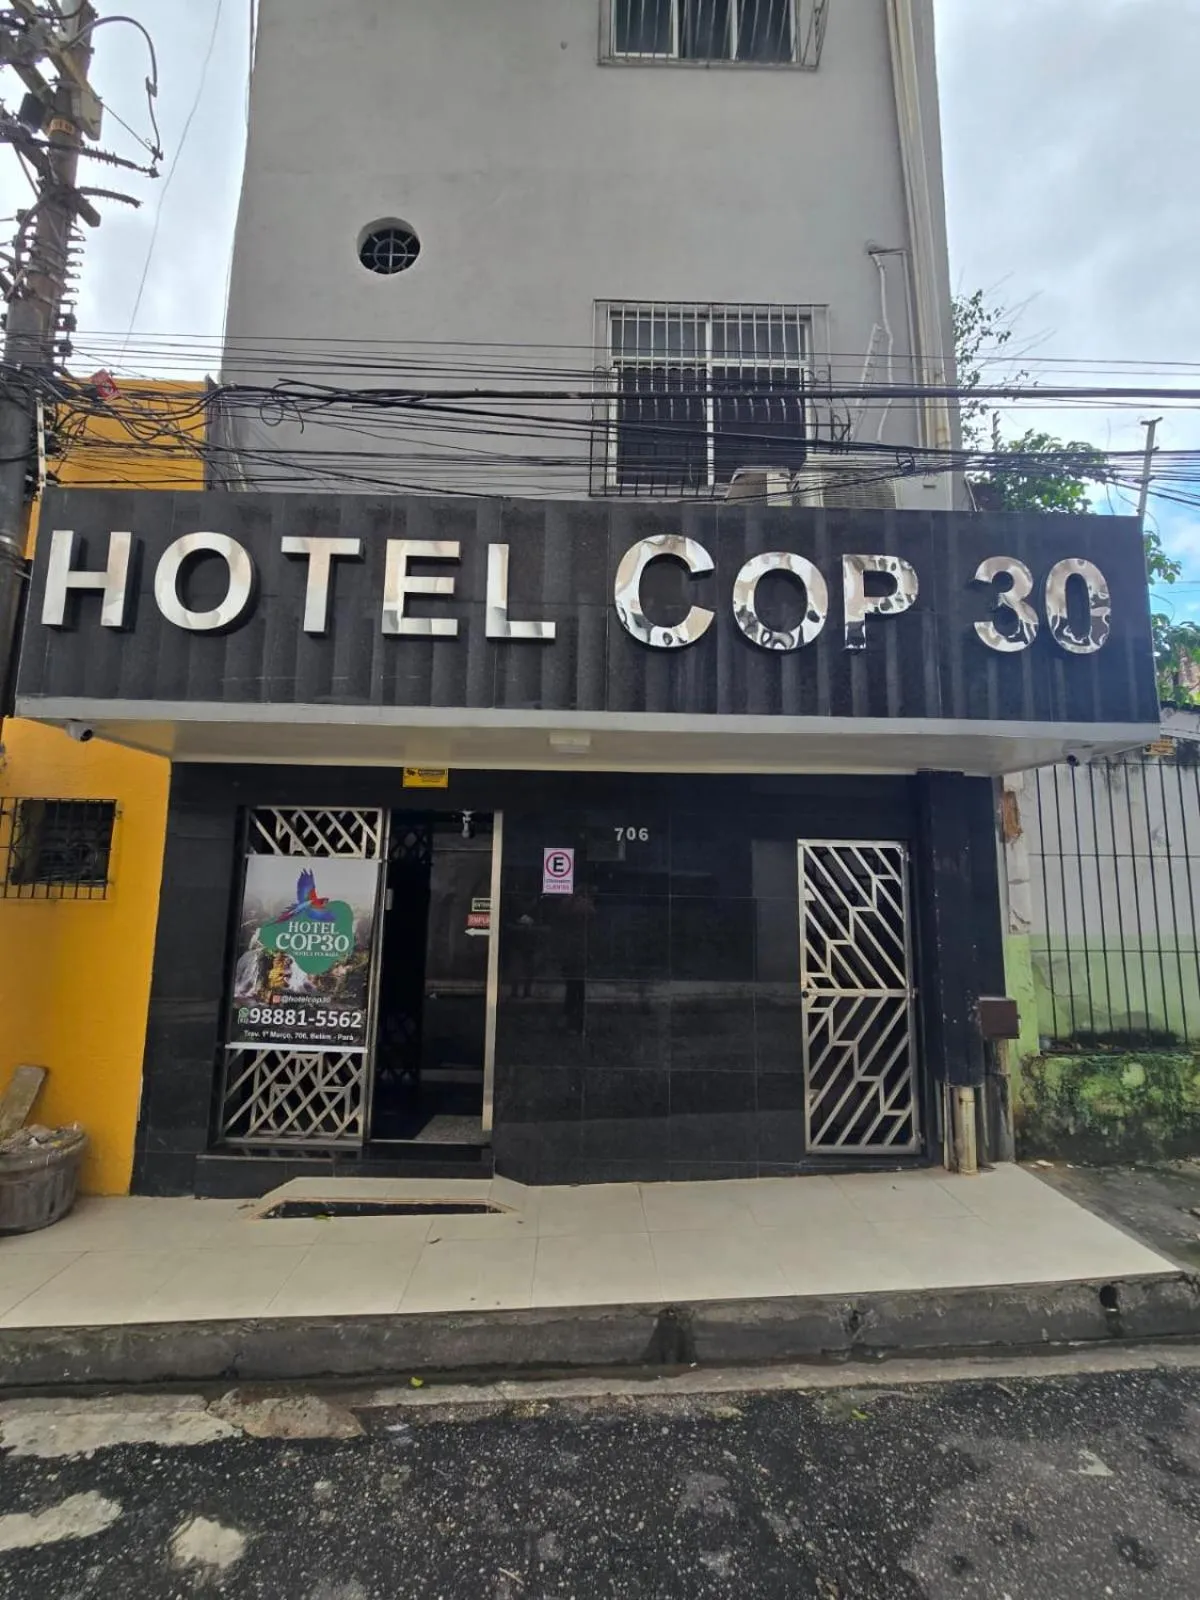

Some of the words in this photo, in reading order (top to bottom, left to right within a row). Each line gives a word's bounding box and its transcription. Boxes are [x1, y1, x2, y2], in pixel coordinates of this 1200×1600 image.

[41, 530, 557, 638] HOTEL
[614, 534, 919, 651] COP
[973, 556, 1111, 654] 30
[614, 826, 649, 841] 706
[553, 857, 564, 872] E
[288, 921, 339, 934] HOTEL
[276, 932, 349, 952] COP30
[249, 1008, 362, 1028] 98881-5562
